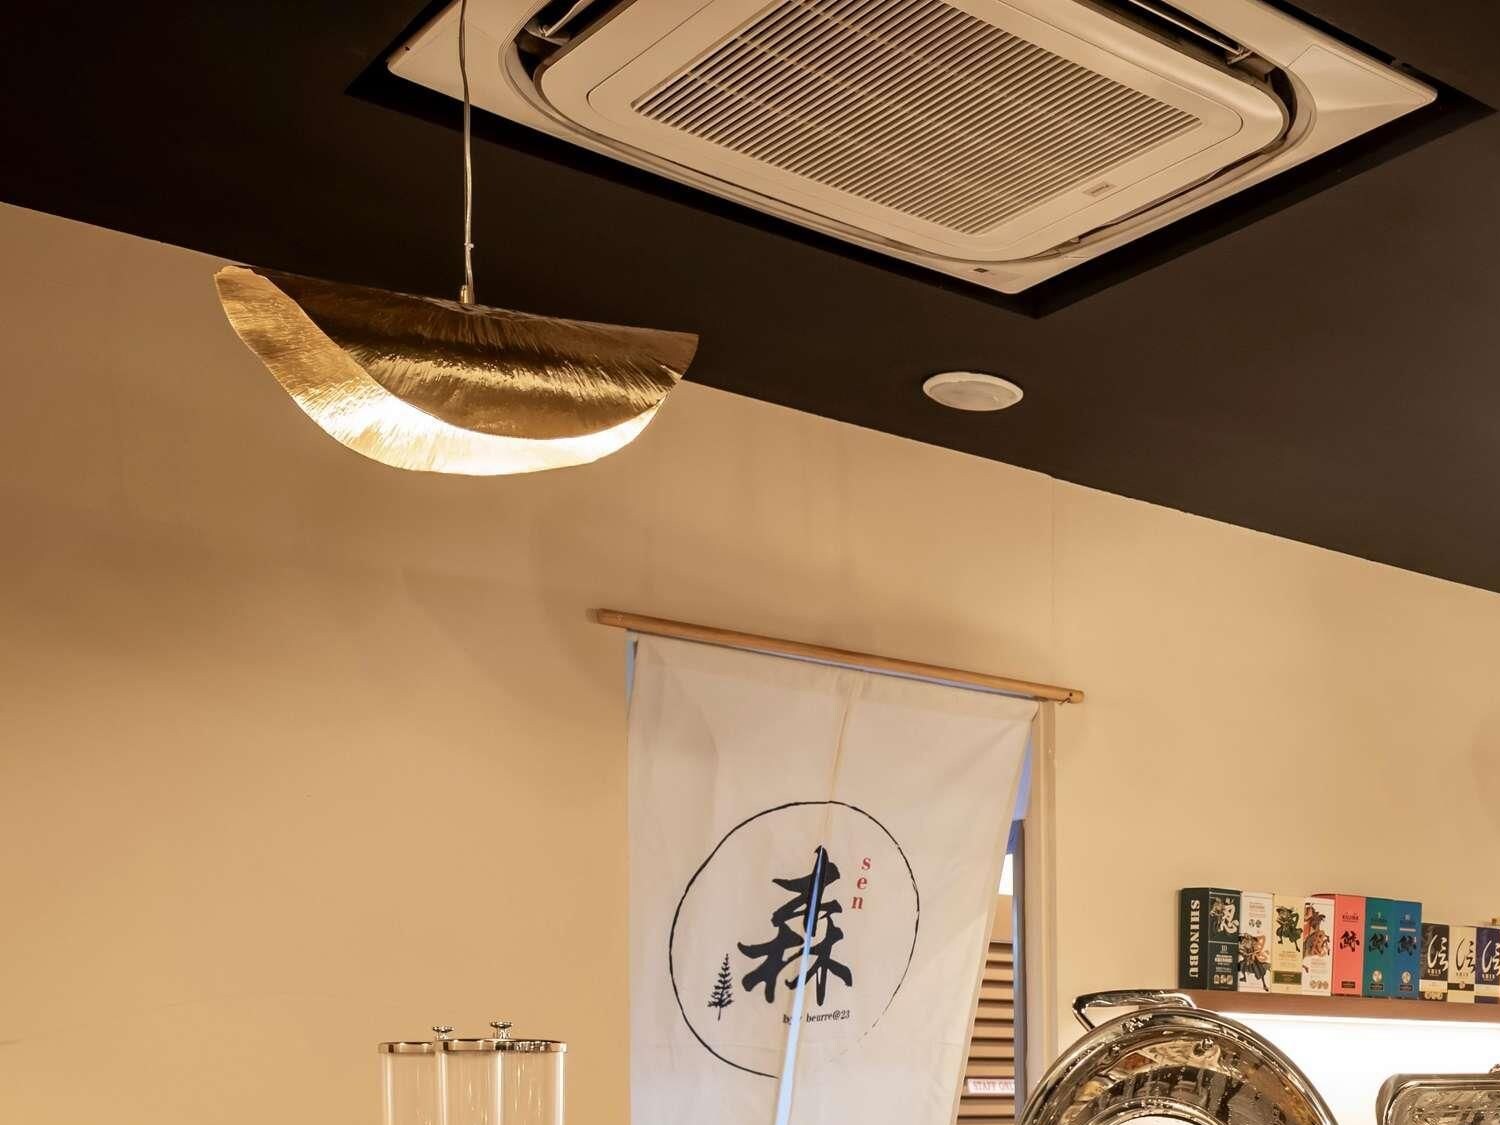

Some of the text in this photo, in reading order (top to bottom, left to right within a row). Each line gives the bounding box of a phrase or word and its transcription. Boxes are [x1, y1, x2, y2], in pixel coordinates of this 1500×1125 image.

[851, 855, 872, 911] sen
[736, 844, 853, 1006] 森
[1189, 899, 1201, 978] SHINOBU
[806, 1009, 850, 1023] beurre@23
